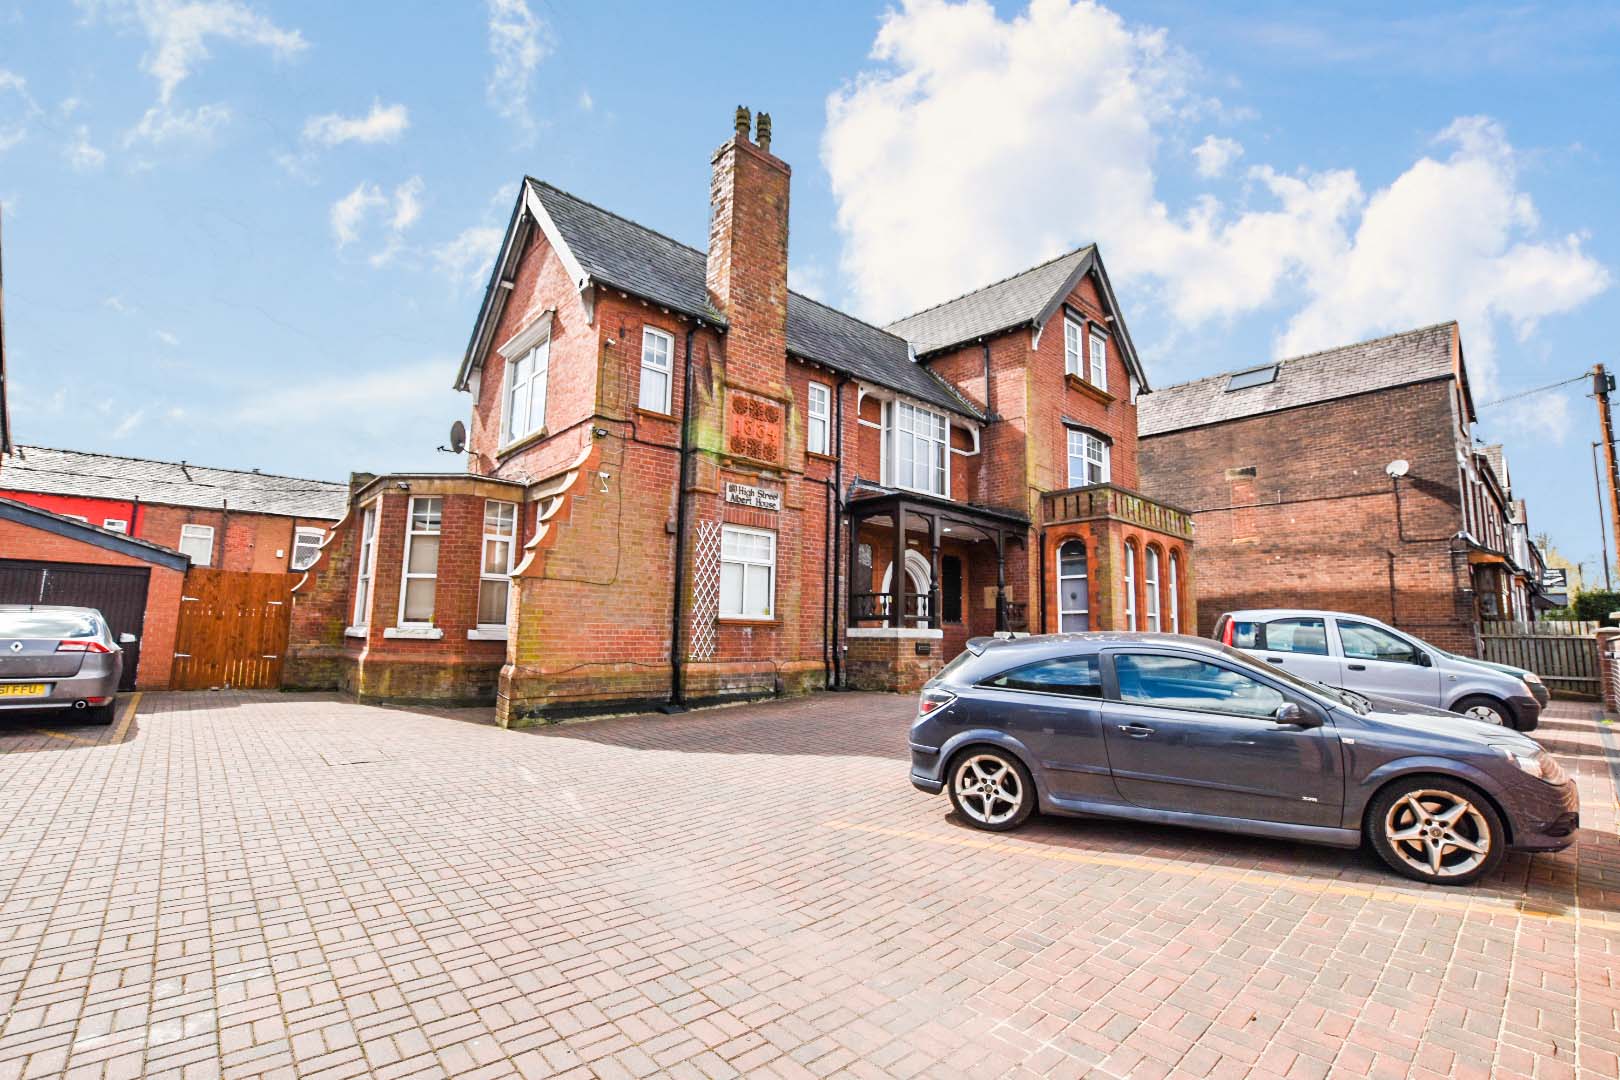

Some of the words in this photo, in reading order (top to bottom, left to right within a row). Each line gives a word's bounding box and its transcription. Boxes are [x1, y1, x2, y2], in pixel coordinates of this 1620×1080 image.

[730, 493, 752, 505] Albert
[755, 497, 777, 509] House
[738, 486, 755, 498] High
[757, 489, 779, 501] Street
[12, 683, 38, 694] FFU
